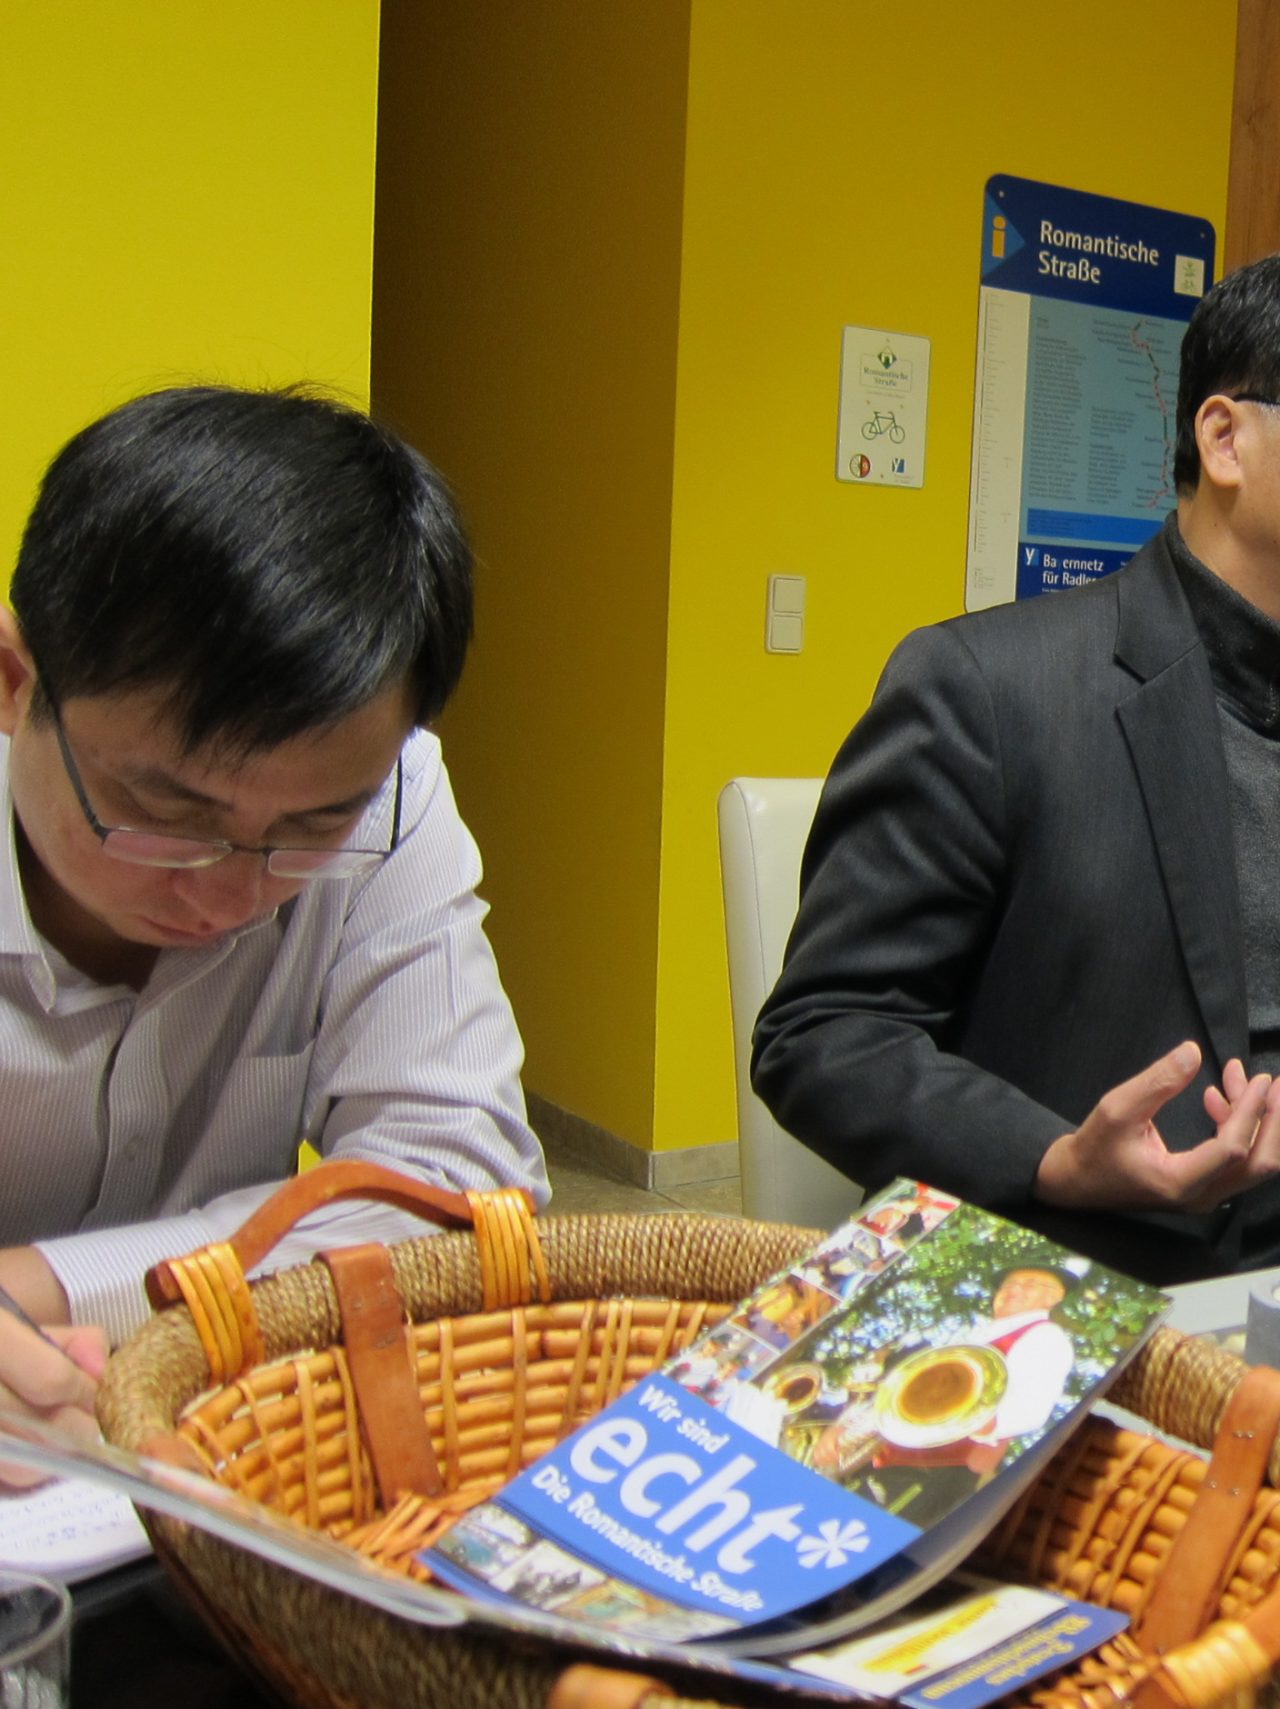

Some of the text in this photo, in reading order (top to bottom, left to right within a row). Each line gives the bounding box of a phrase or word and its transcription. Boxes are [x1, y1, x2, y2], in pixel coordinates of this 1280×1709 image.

[1040, 219, 1160, 266] Romantische
[1038, 250, 1100, 284] Straße
[1042, 570, 1059, 585] für
[638, 1384, 731, 1454] Wir sind
[531, 1464, 764, 1613] Die Romantische Straße
